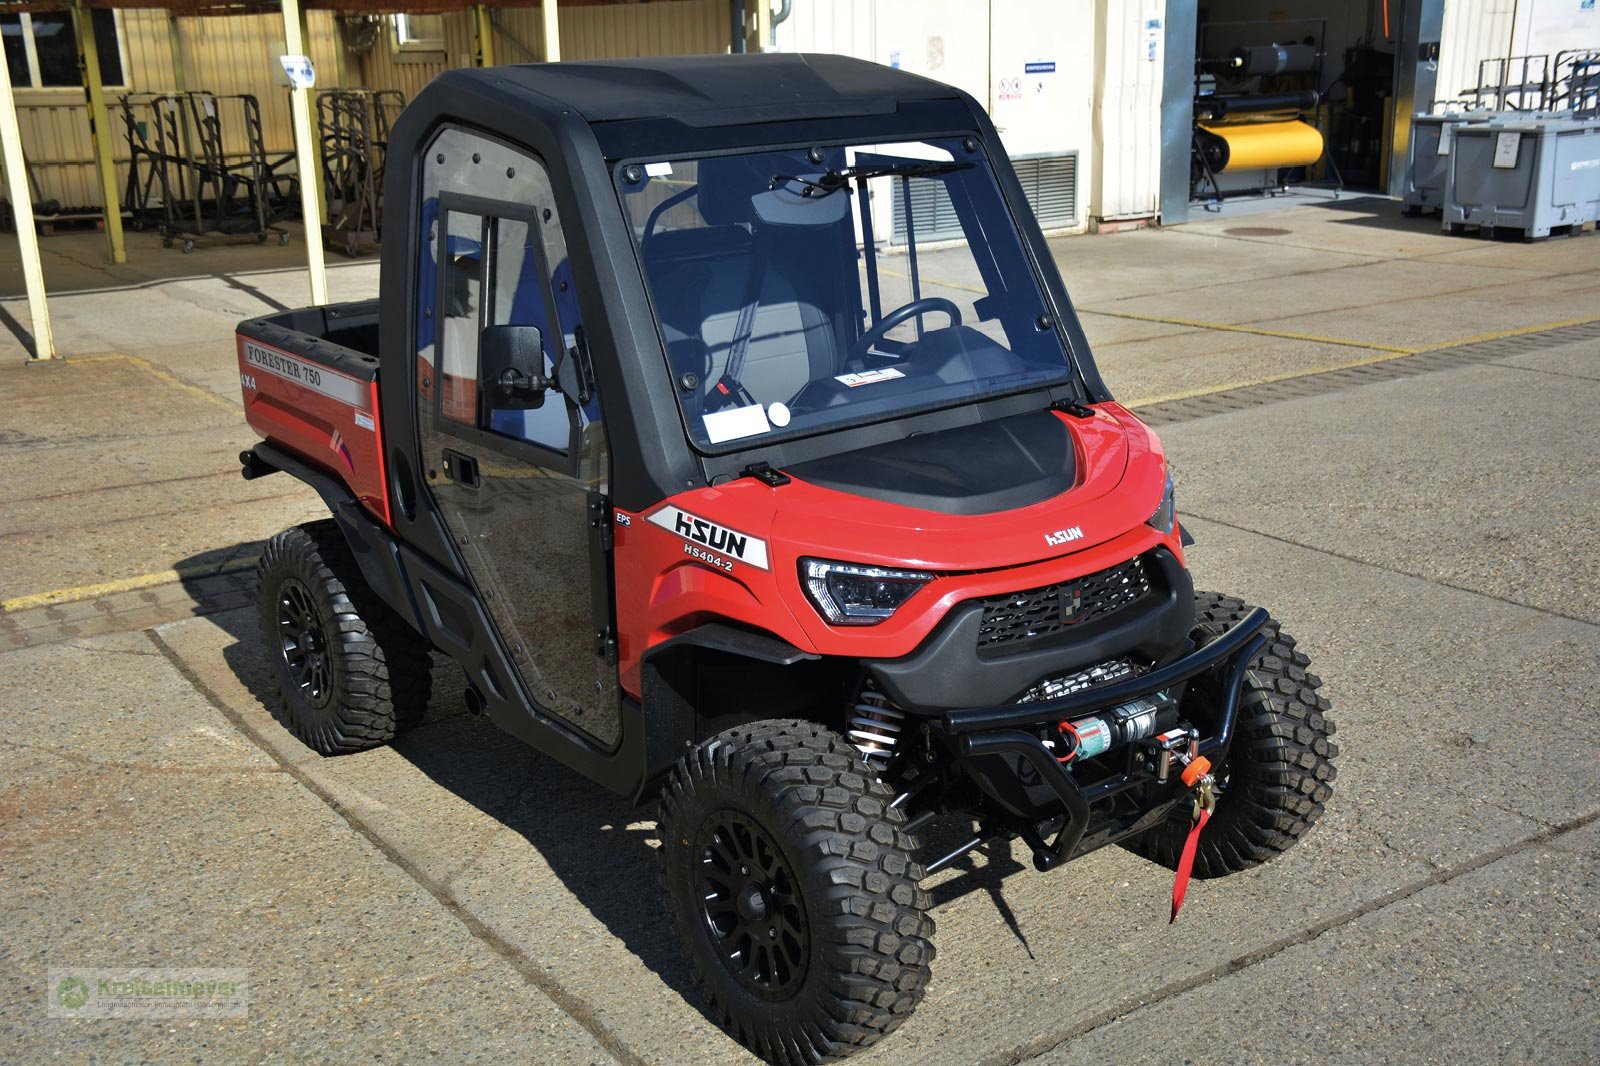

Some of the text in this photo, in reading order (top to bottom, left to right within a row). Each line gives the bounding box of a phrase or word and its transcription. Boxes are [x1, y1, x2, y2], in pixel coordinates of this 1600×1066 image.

[248, 345, 321, 387] FORESTER 750
[616, 512, 631, 526] EPS
[684, 543, 733, 572] HS404-2
